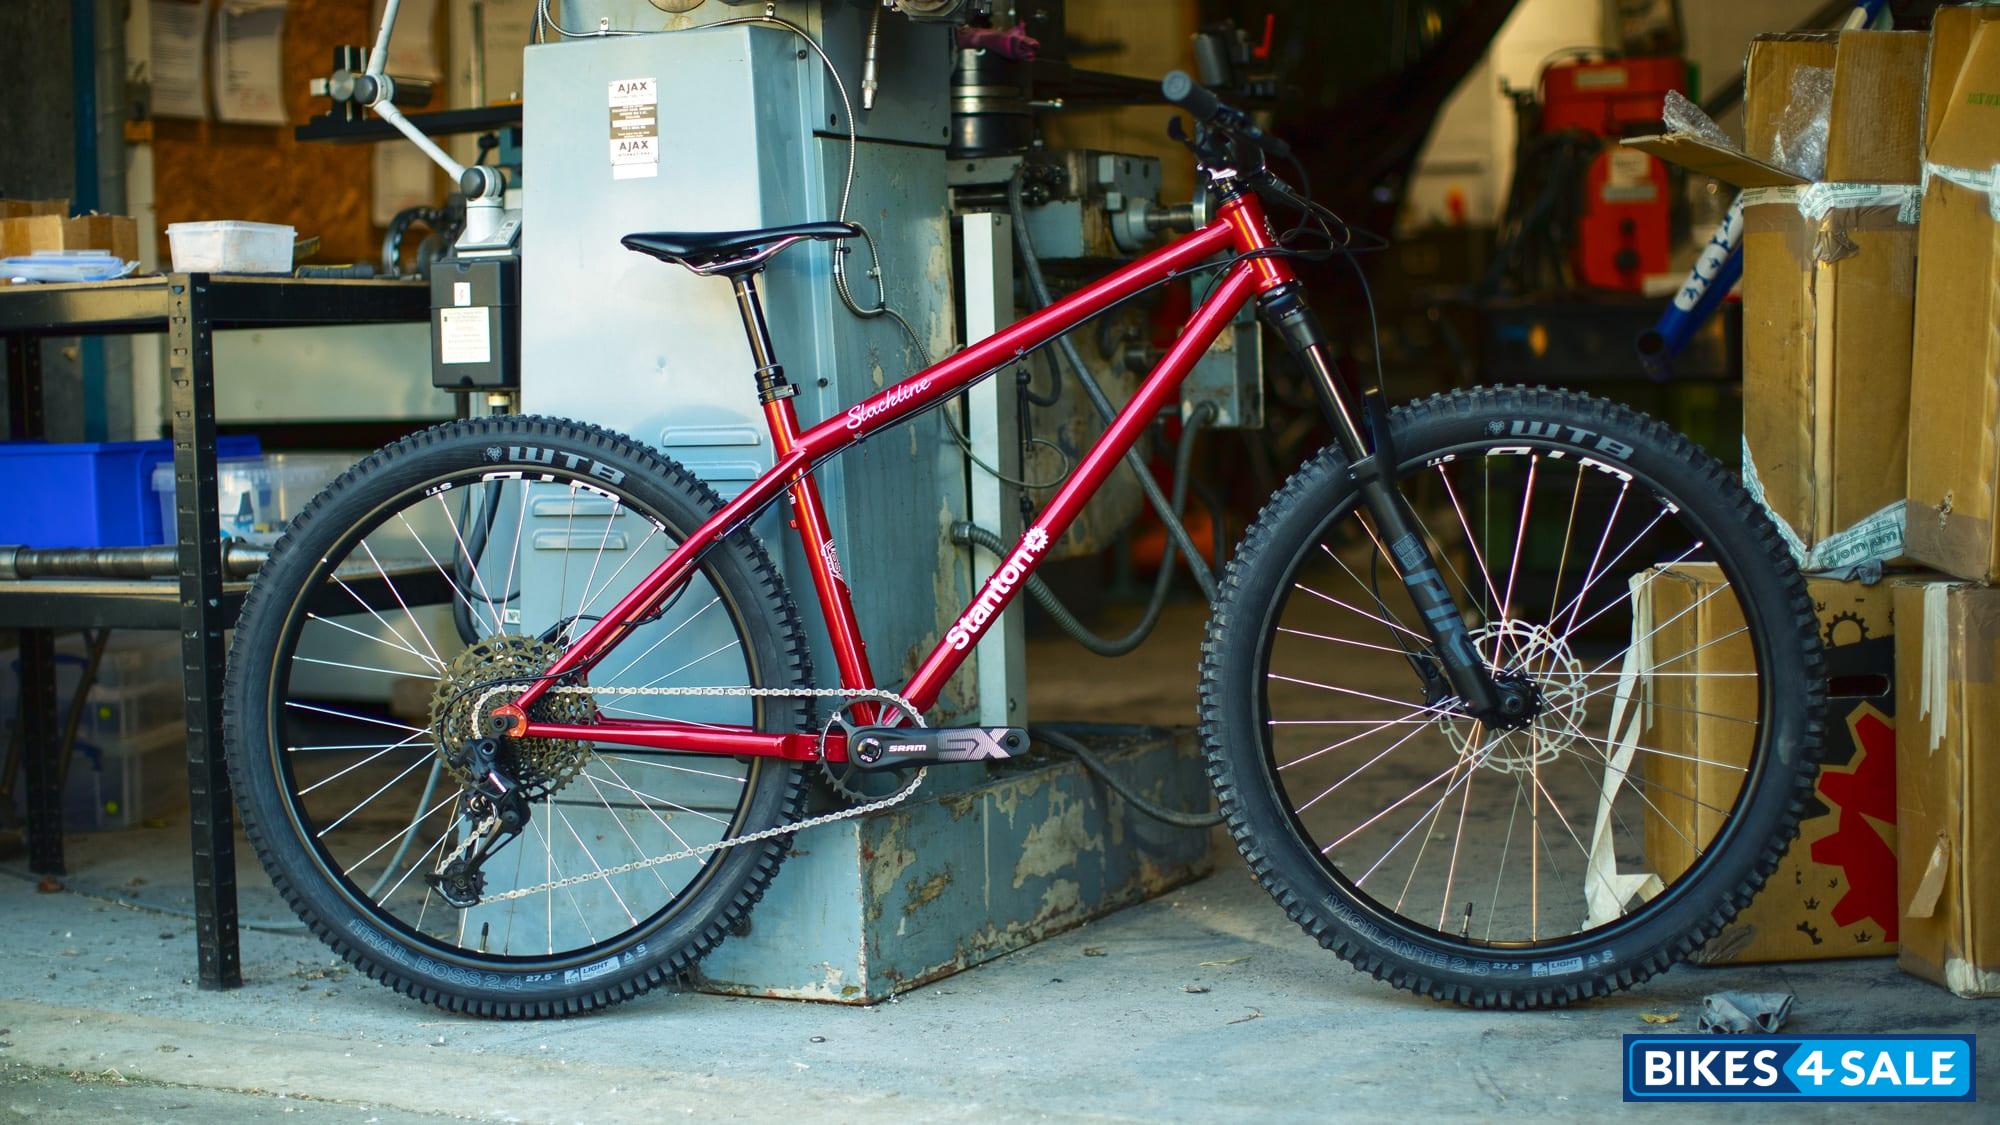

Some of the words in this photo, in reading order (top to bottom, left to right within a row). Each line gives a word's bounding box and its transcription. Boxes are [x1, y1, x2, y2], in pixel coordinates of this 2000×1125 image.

[618, 82, 647, 94] AJAX
[619, 141, 649, 152] AJAX
[846, 378, 932, 430] Slackline
[1510, 420, 1634, 460] WTB
[508, 446, 627, 485] WTB
[945, 548, 1034, 651] Stanton
[888, 744, 927, 752] SRAM
[936, 728, 1011, 760] SX
[351, 919, 409, 965] TRAIL
[415, 956, 482, 988] BOSS
[483, 974, 522, 990] 2.4
[582, 960, 609, 974] LIGHT
[1322, 894, 1449, 970] VIGILANTE
[1450, 958, 1491, 977] 2.5
[1550, 959, 1578, 968] LIGHT
